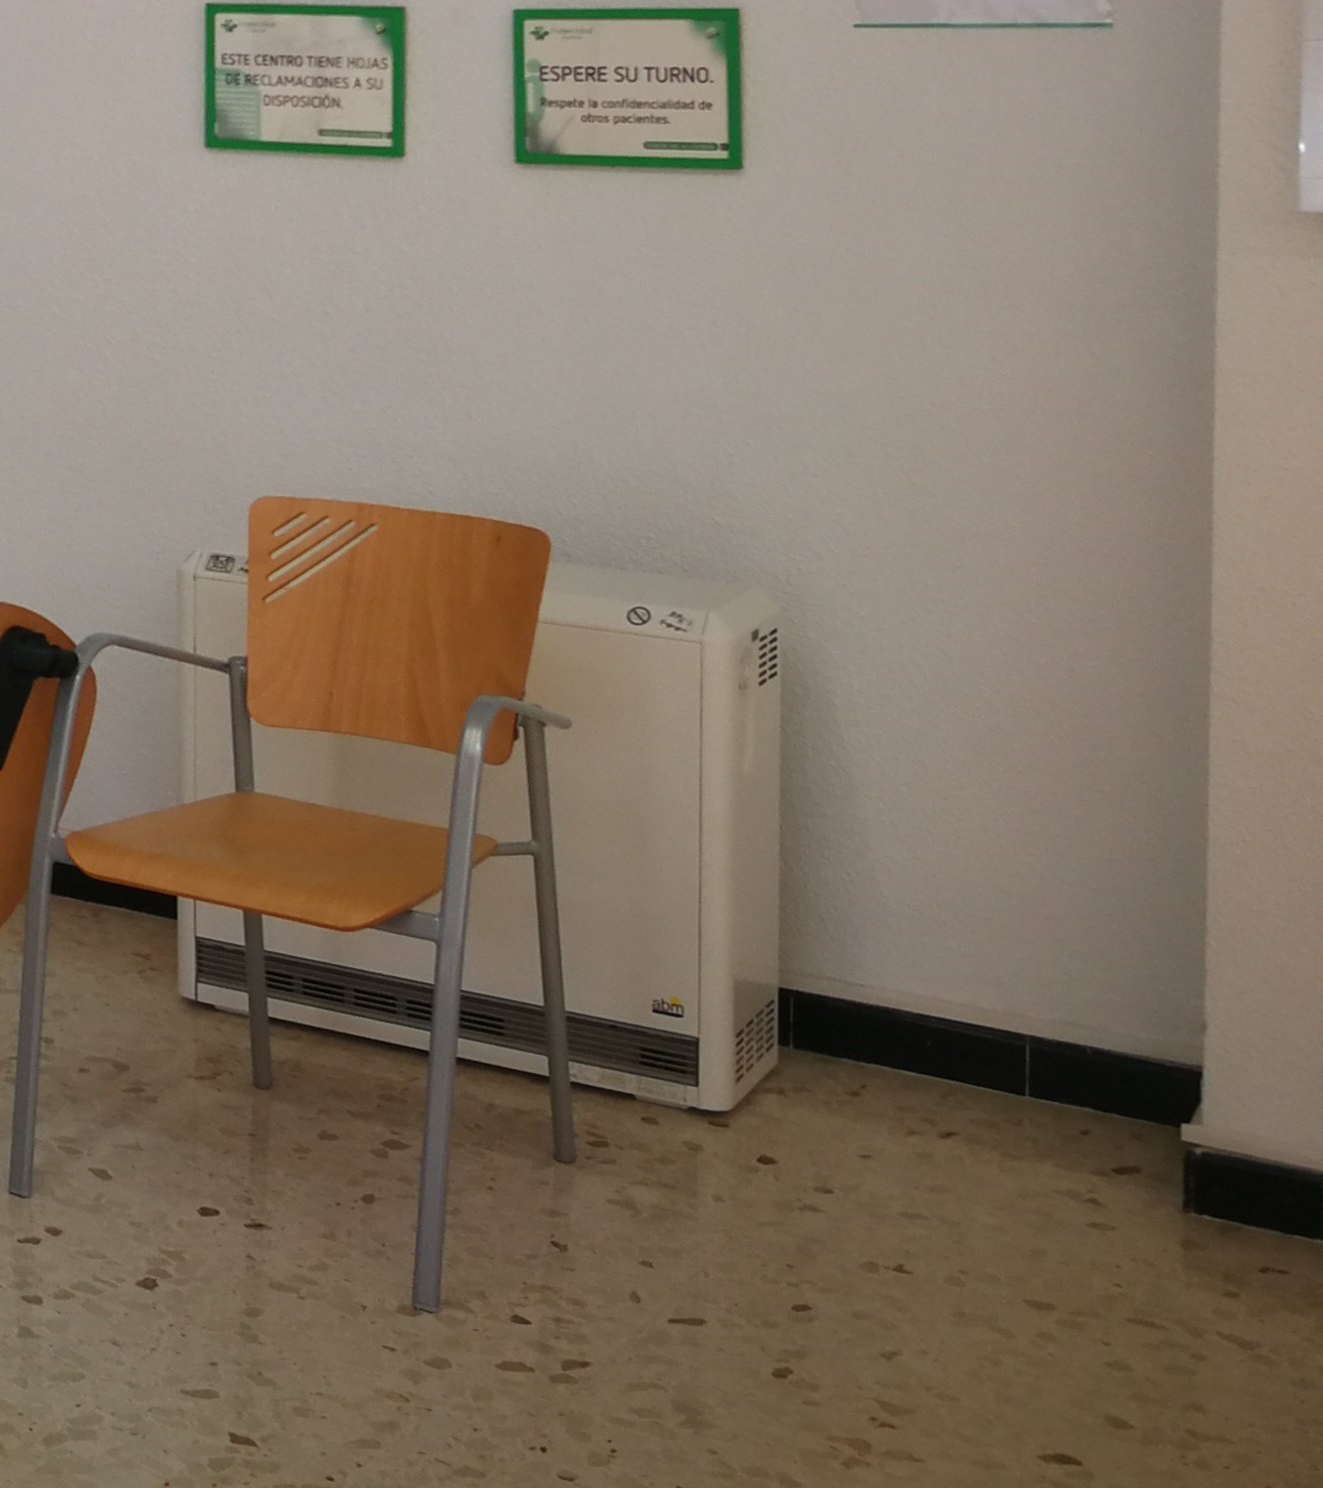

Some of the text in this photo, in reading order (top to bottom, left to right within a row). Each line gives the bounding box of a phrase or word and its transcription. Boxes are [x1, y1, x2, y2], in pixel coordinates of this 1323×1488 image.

[220, 53, 389, 71] ESTE CENTRO TIENE HOJAS
[225, 72, 384, 90] DE RECLAMACIONES A SU
[539, 65, 715, 84] ESPERE SU TURNO.
[539, 97, 714, 111] Respete la confidencialidad de
[580, 113, 671, 125] otros pacientes.
[652, 998, 684, 1015] abm
